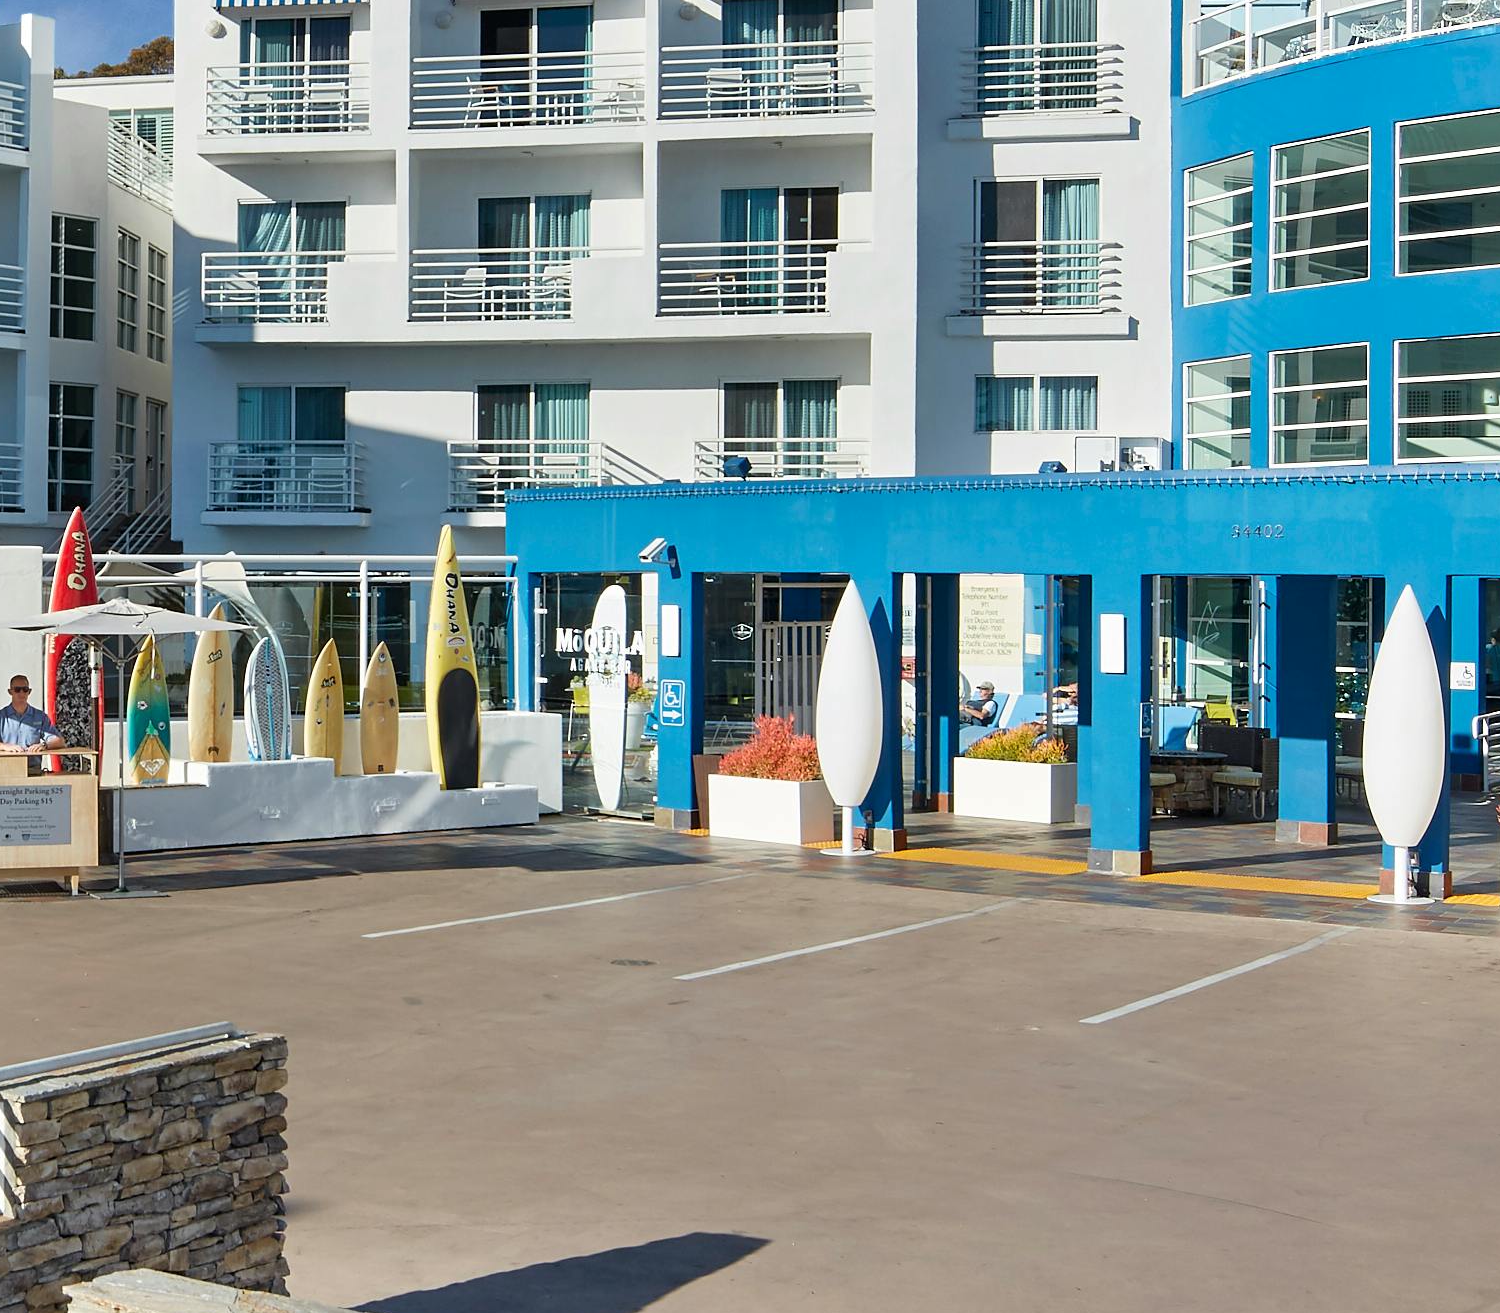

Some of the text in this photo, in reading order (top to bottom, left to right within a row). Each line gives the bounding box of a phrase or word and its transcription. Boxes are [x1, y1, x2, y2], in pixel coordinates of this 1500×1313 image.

[1231, 524, 1285, 538] 34402
[445, 572, 460, 634] OHANA
[25, 787, 50, 796] Parking
[0, 798, 13, 806] Day
[15, 798, 40, 806] Parking
